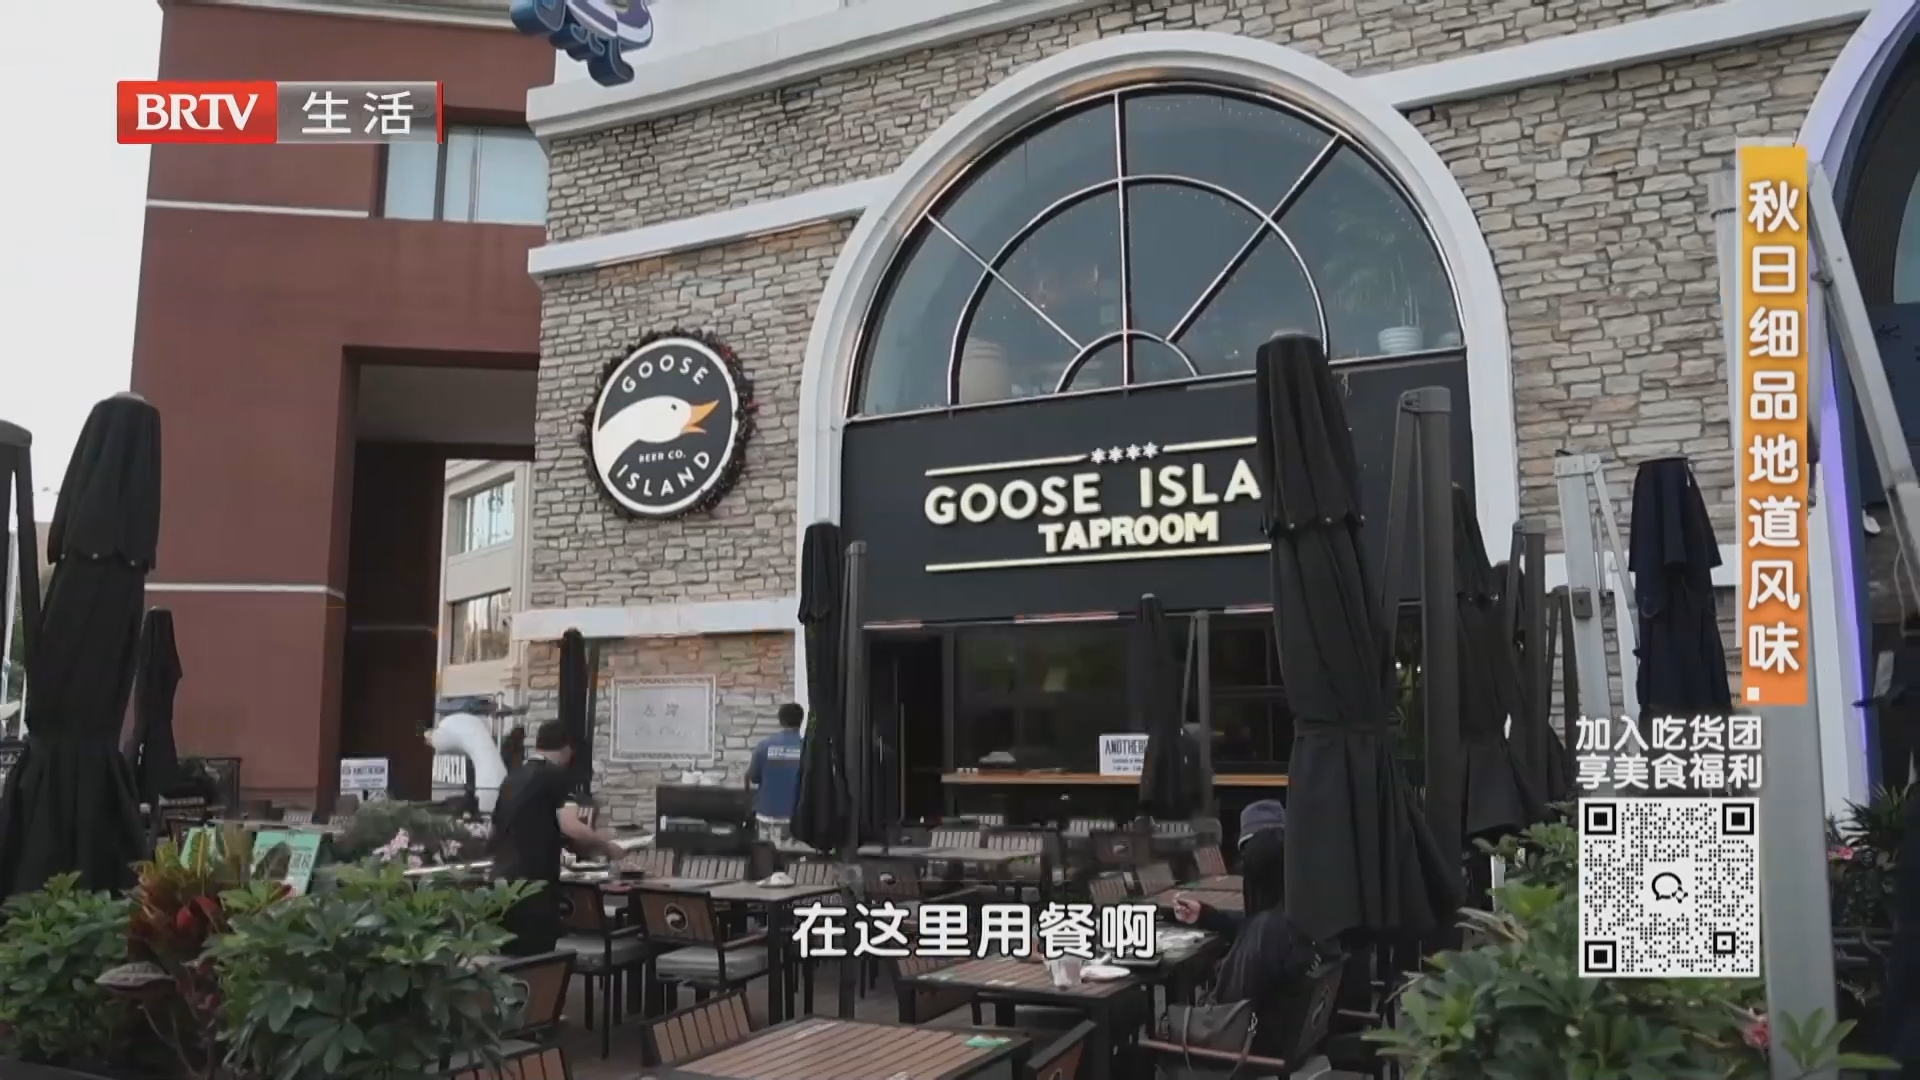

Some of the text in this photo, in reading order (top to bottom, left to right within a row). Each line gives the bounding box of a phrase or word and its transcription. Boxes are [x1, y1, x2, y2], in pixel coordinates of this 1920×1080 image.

[621, 354, 709, 393] GOOSE
[616, 451, 710, 497] ISLAND
[638, 453, 665, 463] BEER
[924, 458, 1262, 525] GOOSE ISLA
[1038, 510, 1220, 554] TAPROOM
